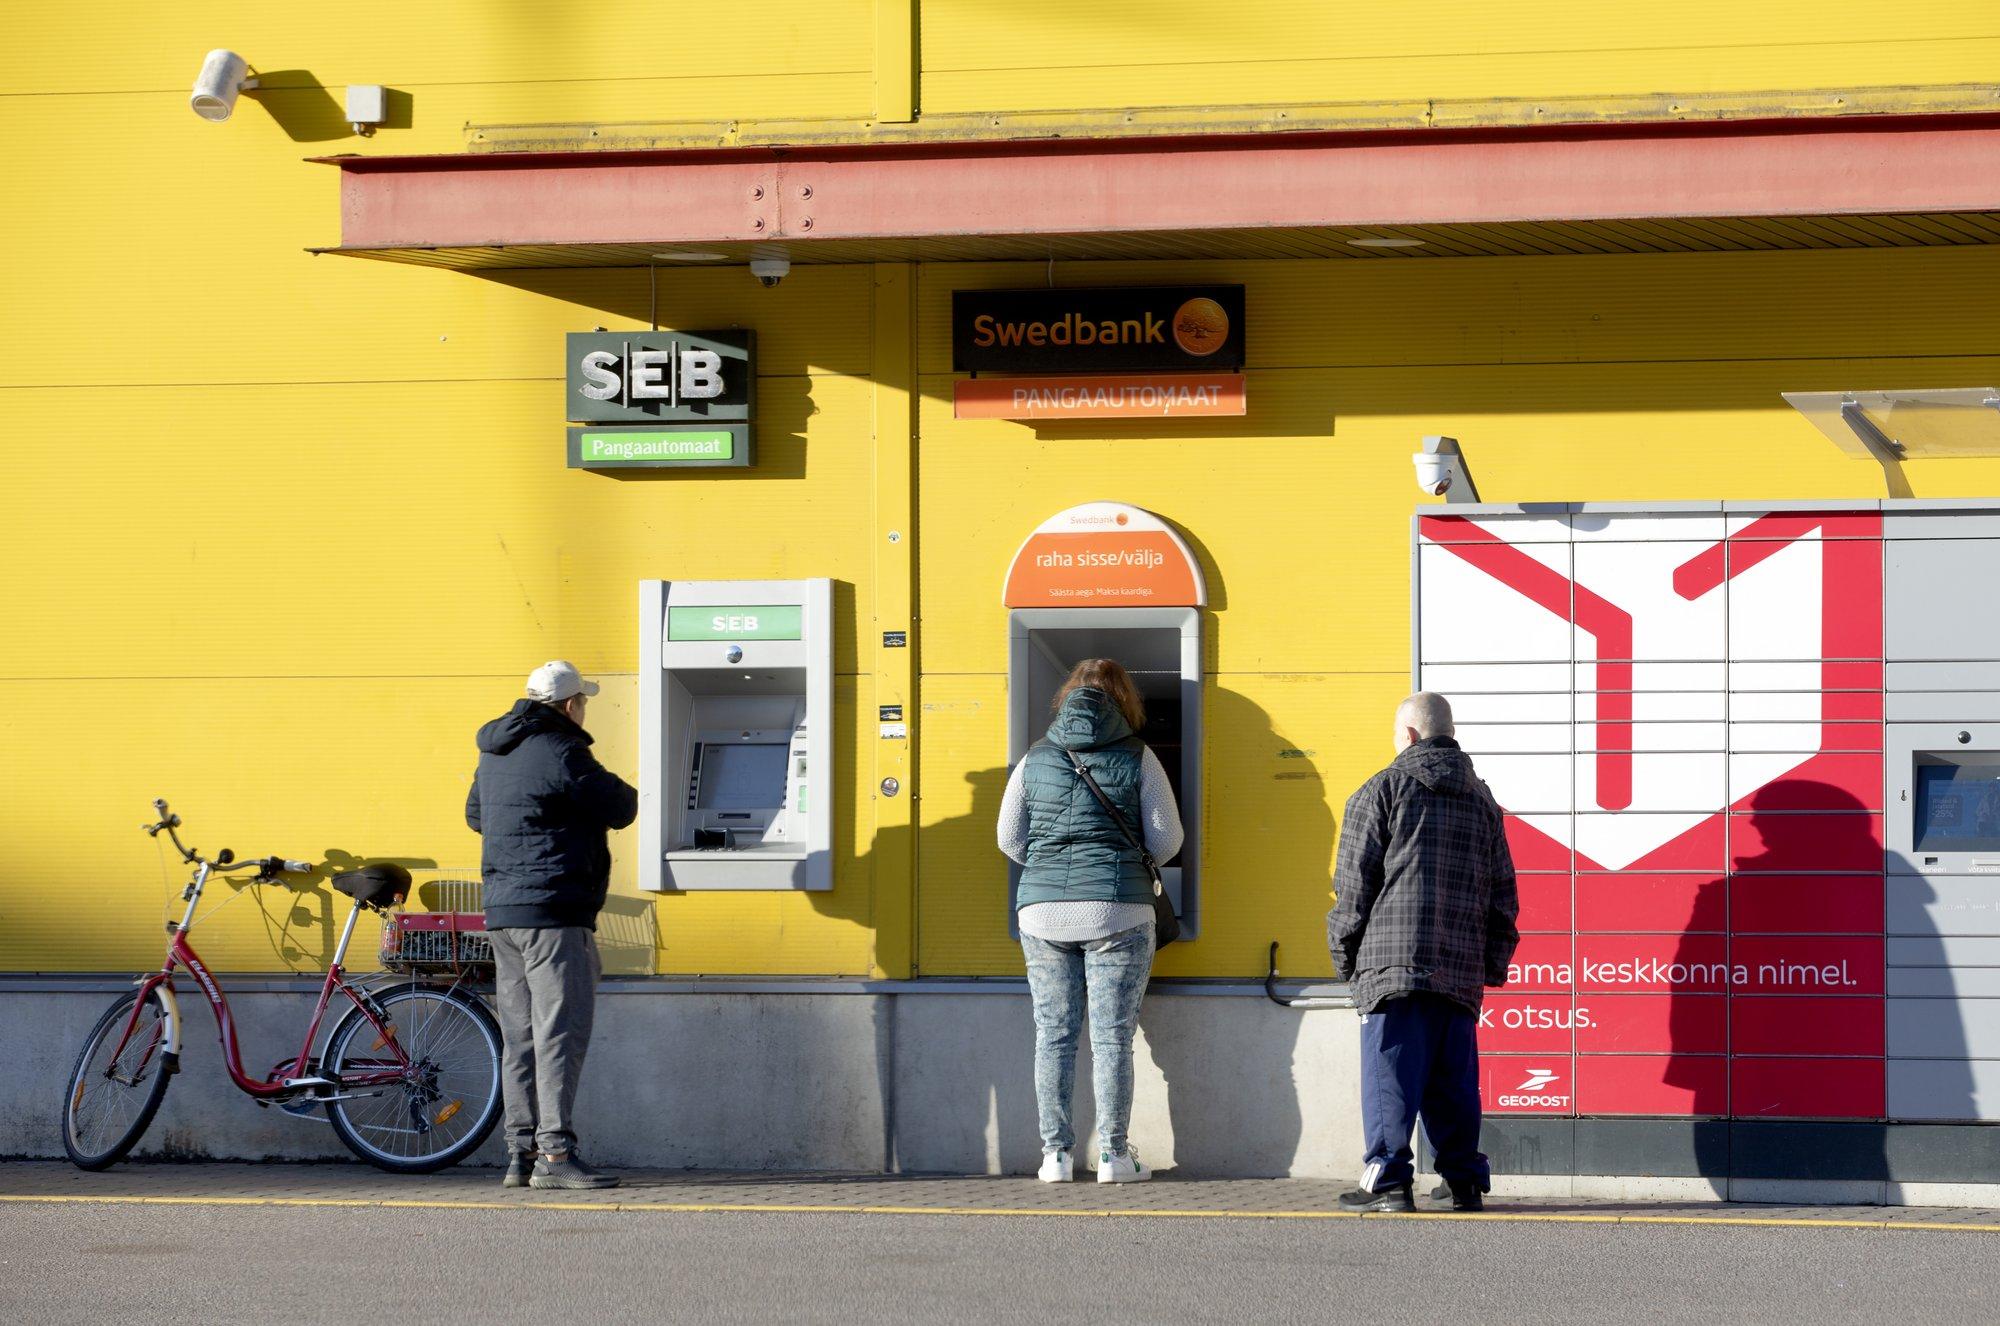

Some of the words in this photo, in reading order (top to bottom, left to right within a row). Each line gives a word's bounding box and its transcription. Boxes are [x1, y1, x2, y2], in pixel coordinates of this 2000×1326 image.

[973, 311, 1166, 347] Swedbank
[579, 350, 725, 401] SEB
[1013, 385, 1223, 410] PANGAAUTOMAAT
[592, 438, 721, 459] Pangaautomaat
[1069, 514, 1115, 525] Swedbank
[1036, 550, 1073, 567] raha
[1077, 549, 1163, 568] sisse/välja
[1097, 587, 1119, 597] Maksa
[711, 615, 759, 632] SEB
[1583, 957, 1748, 984] keskkonna
[1759, 958, 1858, 986] nimel.
[1502, 1004, 1597, 1029] otsus.
[1498, 1095, 1570, 1107] GEOPOST
